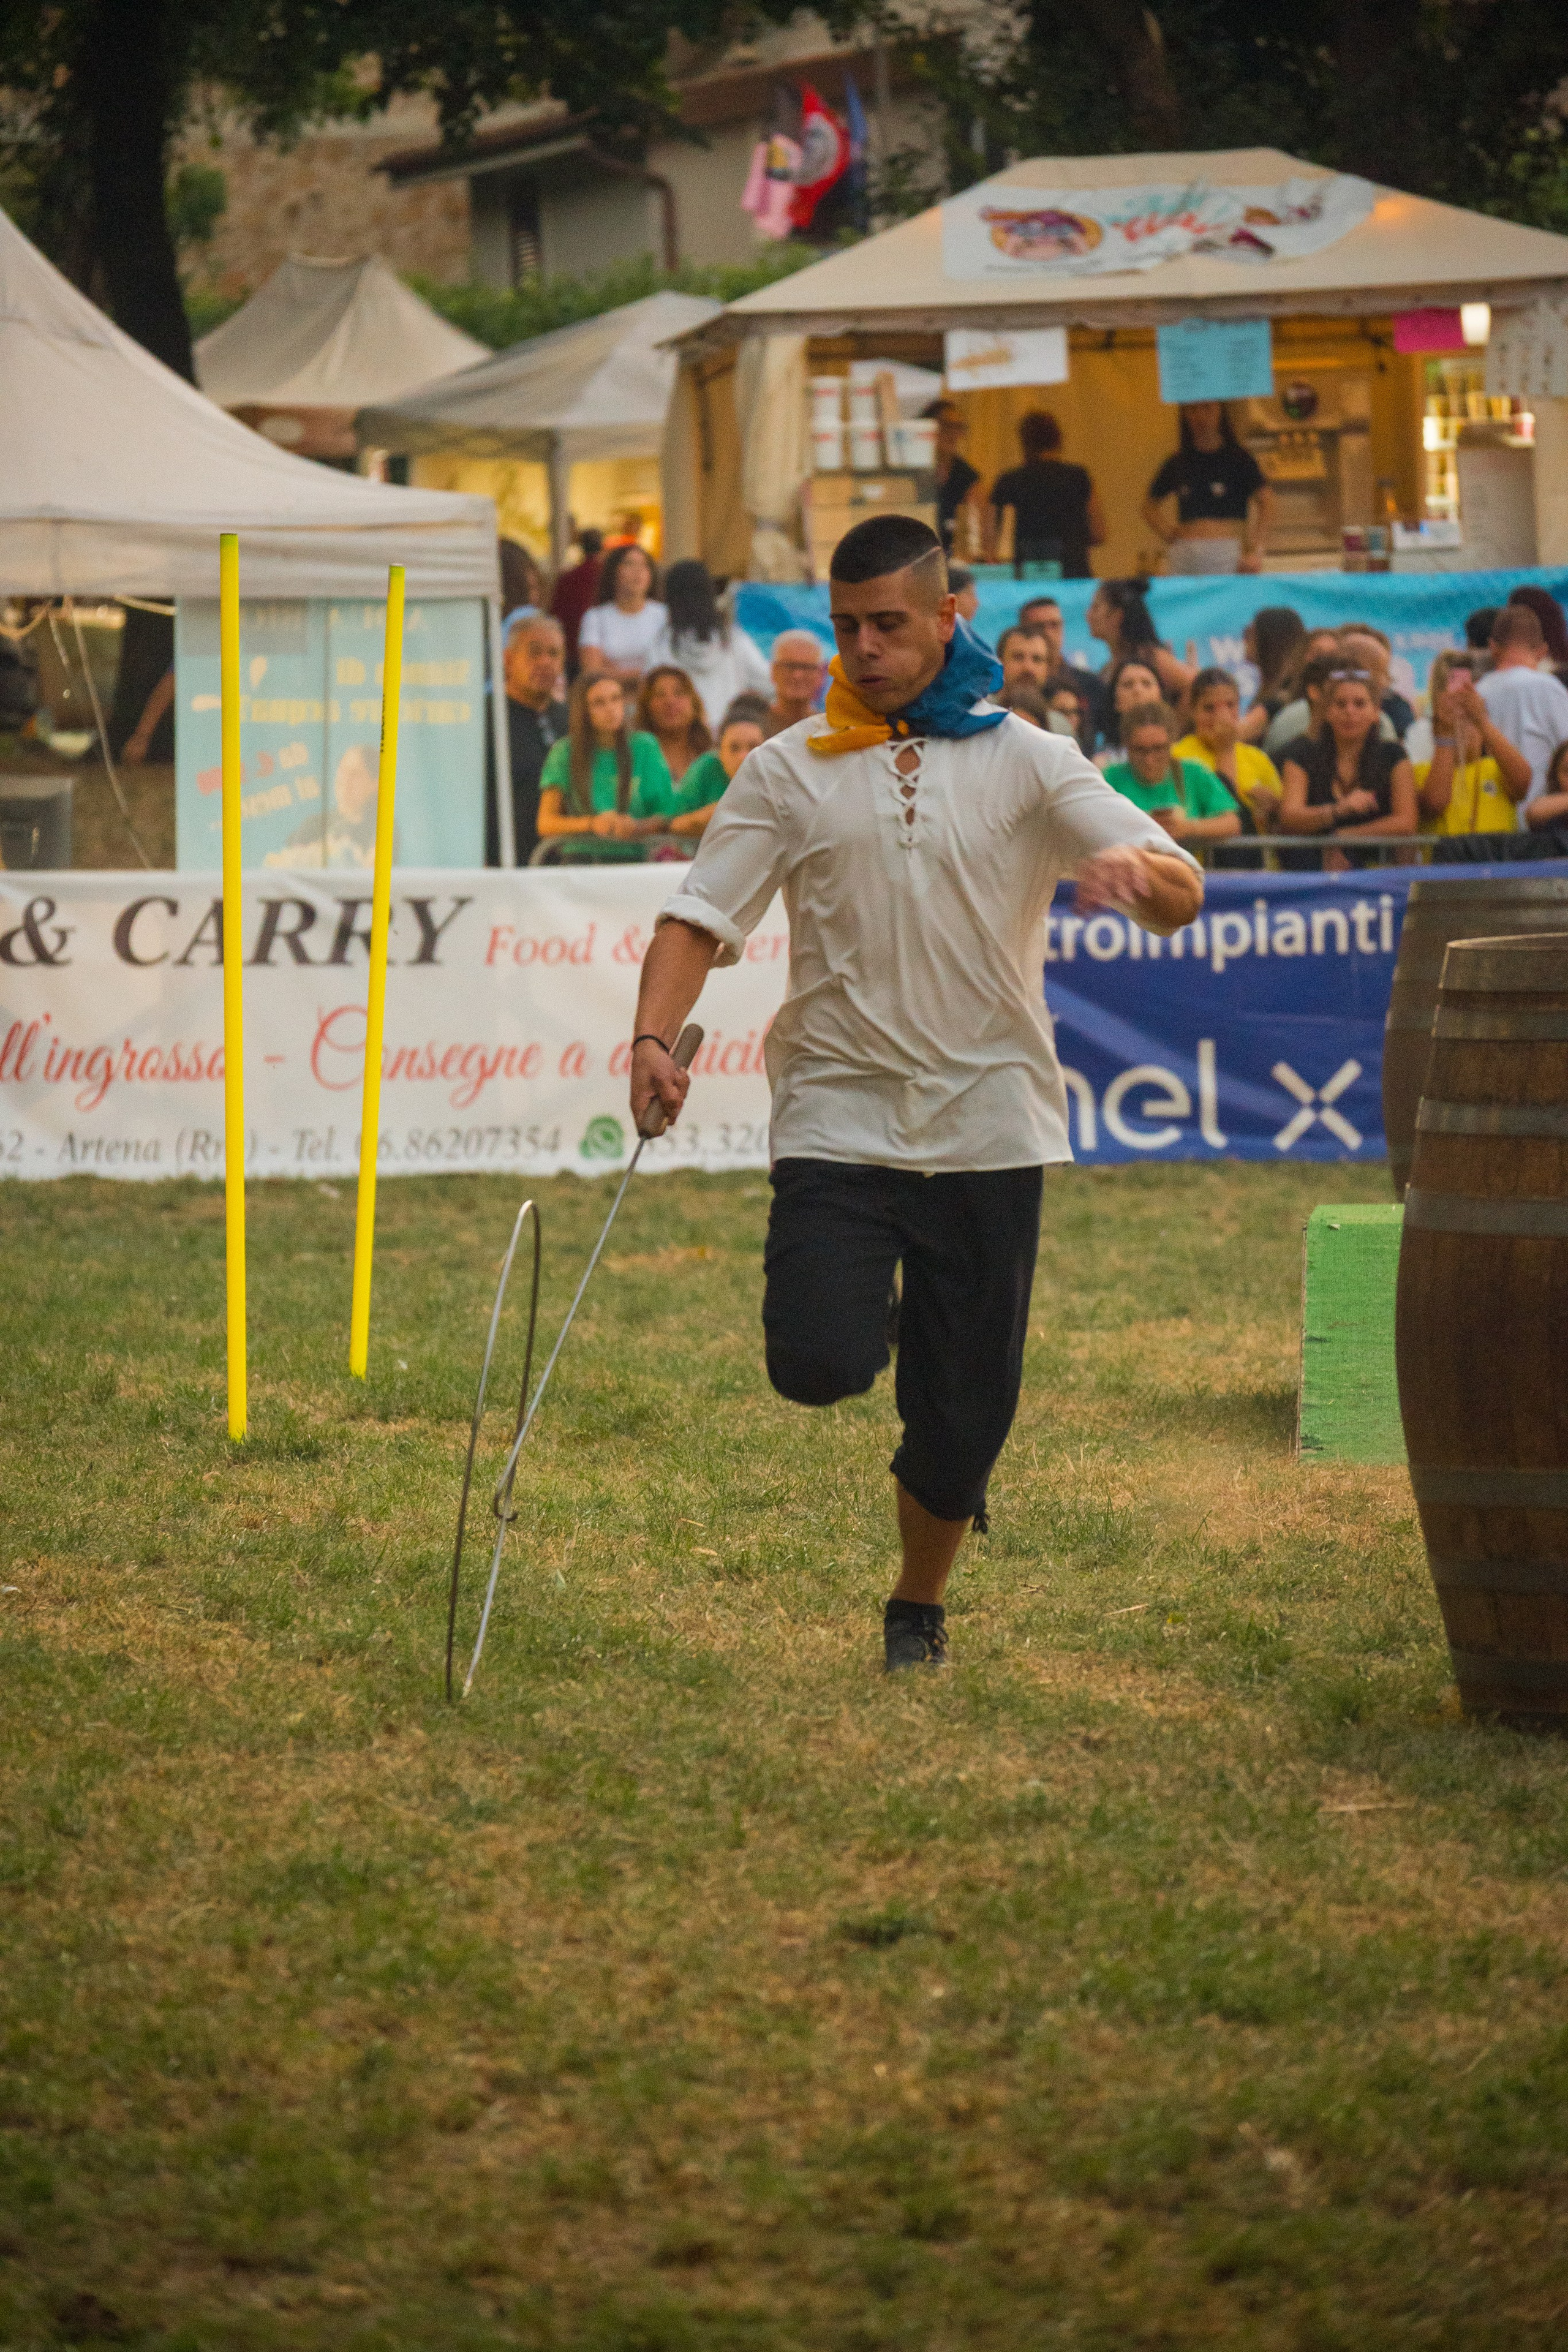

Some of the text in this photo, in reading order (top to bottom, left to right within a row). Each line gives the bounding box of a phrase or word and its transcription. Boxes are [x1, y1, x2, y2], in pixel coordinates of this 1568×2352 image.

[0, 896, 75, 967] &
[112, 895, 473, 967] CARRY
[484, 921, 597, 967] Food
[559, 1041, 589, 1079] a
[59, 1130, 162, 1164] Artena
[292, 1125, 342, 1162] Tel.
